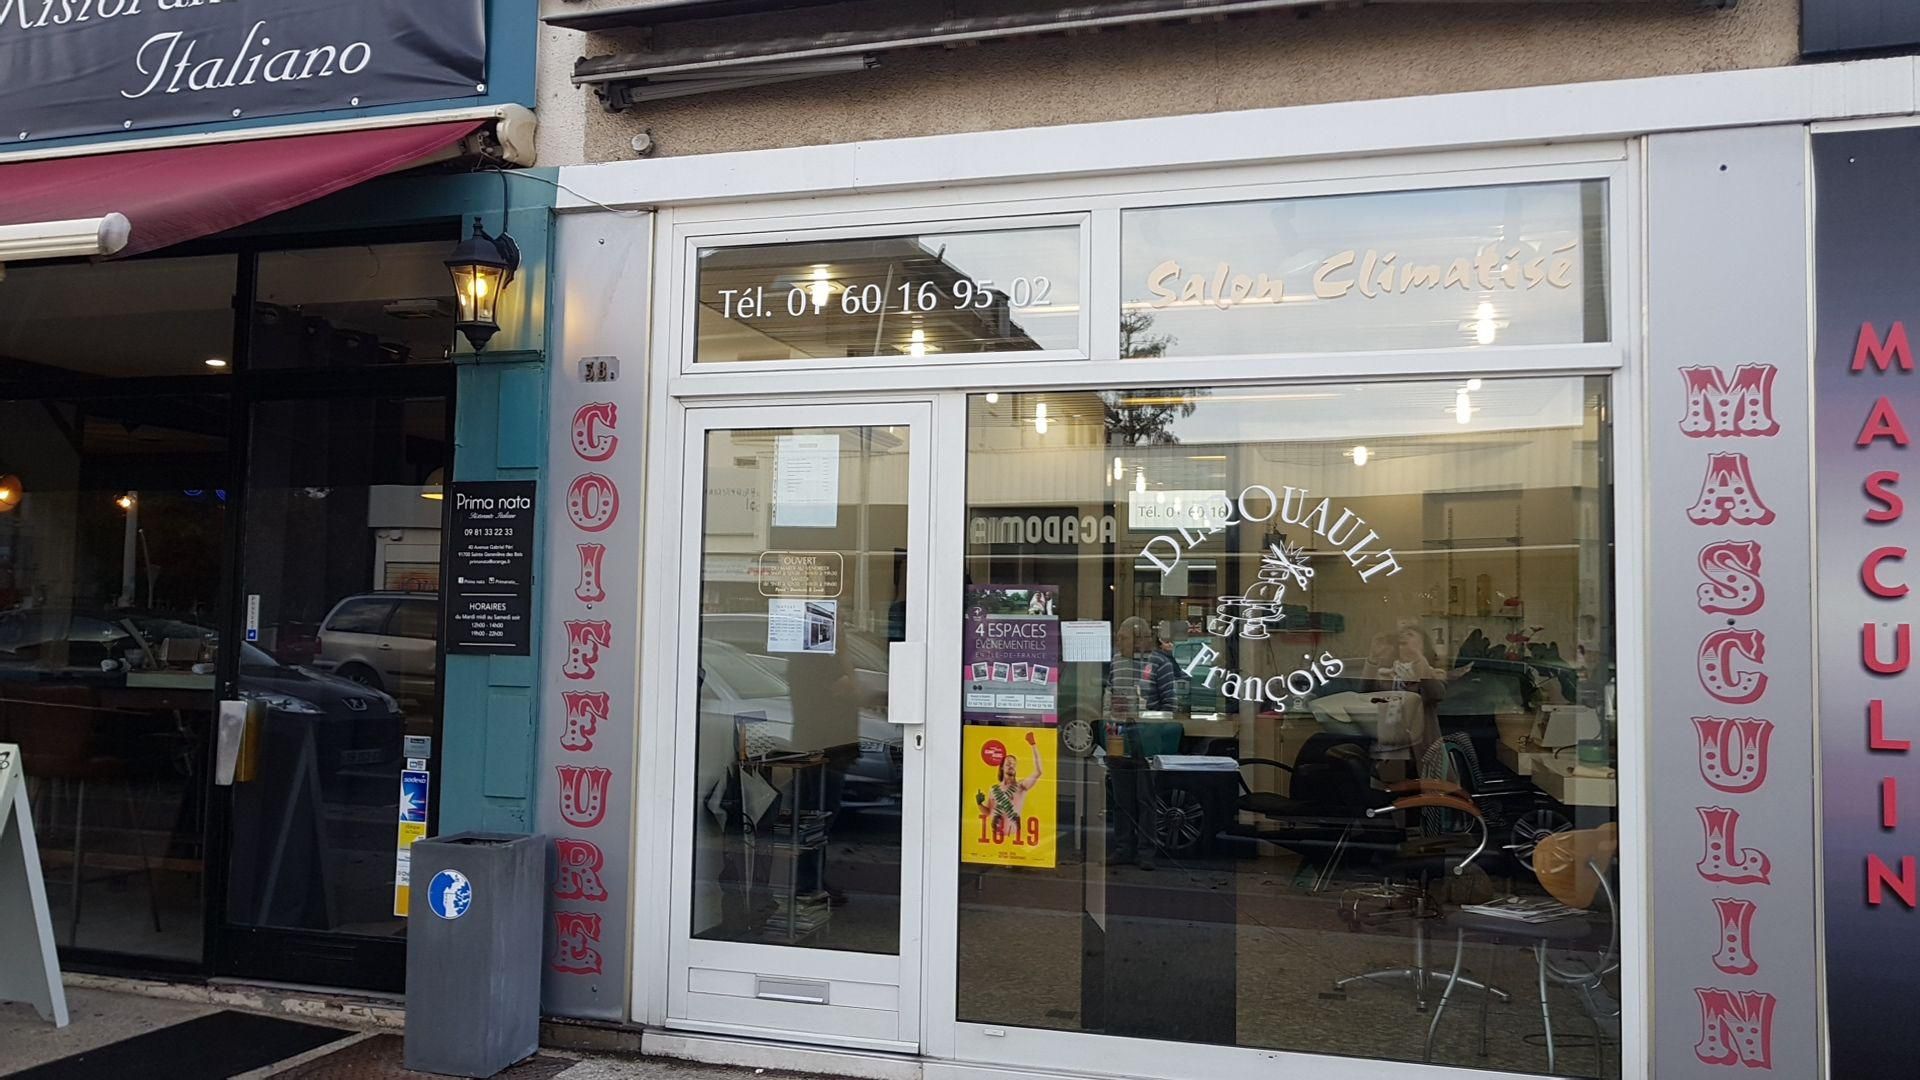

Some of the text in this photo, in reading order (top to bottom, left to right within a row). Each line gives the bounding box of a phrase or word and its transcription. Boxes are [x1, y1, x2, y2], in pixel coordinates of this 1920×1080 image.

[120, 20, 371, 98] Italiano
[1146, 239, 1578, 310] Salon Climatisé
[718, 286, 772, 319] Tél.
[841, 284, 881, 315] 60
[898, 281, 937, 311] 16
[952, 279, 994, 310] 95
[1010, 277, 1052, 308] 02
[456, 493, 531, 510] Prima nata
[1138, 505, 1161, 518] Tél.
[494, 528, 503, 536] 22
[504, 528, 513, 536] 33
[783, 556, 817, 565] OUVERT
[469, 602, 507, 611] HORAIRES
[1849, 320, 1916, 909] MASCULIN
[975, 623, 1047, 638] 4 ESPACES
[551, 402, 620, 977] COIFFURE
[1181, 642, 1344, 713] François
[1677, 362, 1782, 1072] MASCULIN
